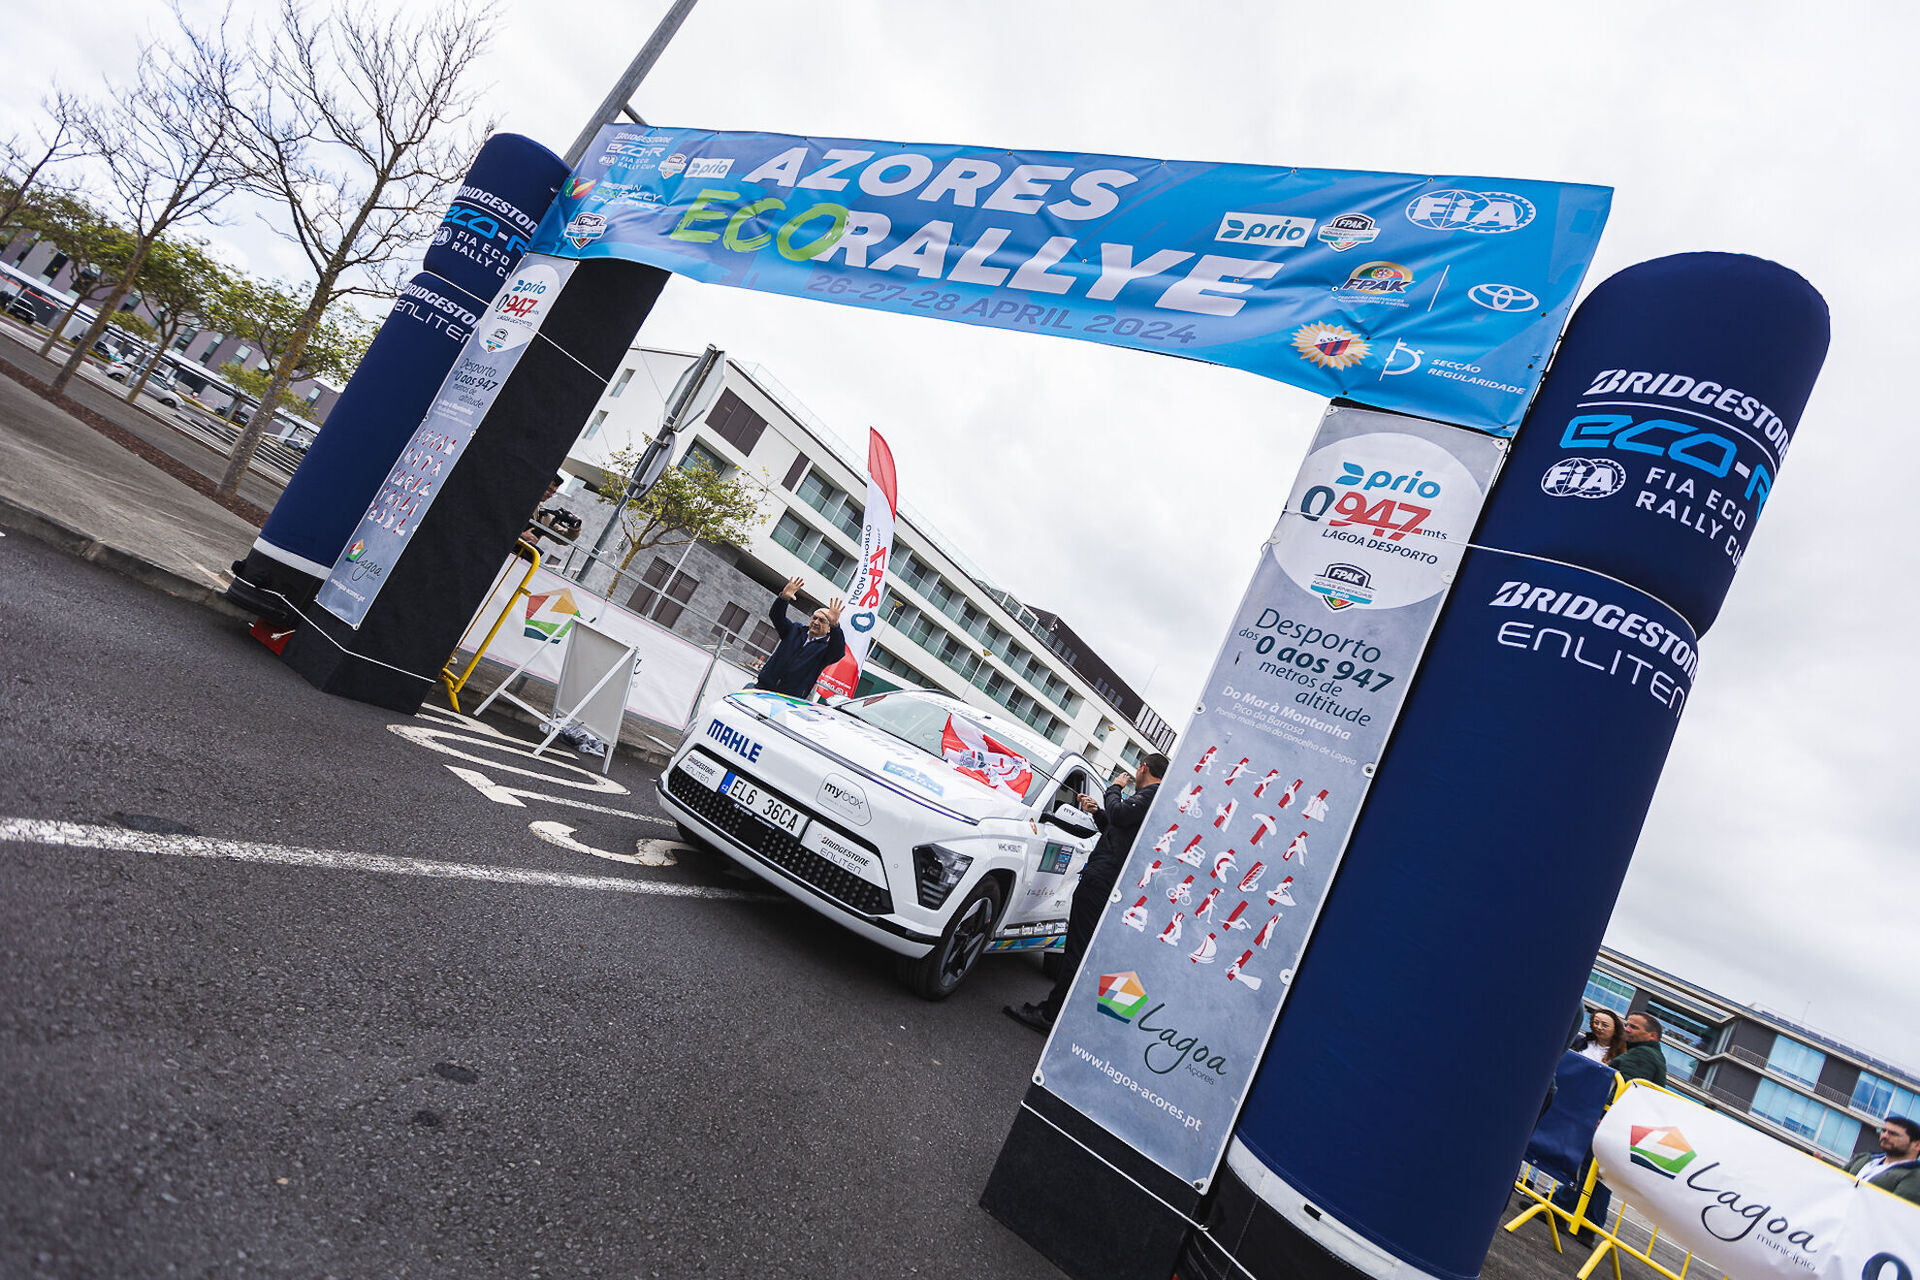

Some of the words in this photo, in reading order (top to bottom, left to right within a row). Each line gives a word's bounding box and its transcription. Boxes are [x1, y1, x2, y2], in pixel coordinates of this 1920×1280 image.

[618, 162, 640, 170] RALLY
[743, 147, 1139, 220] AZORES
[1244, 219, 1306, 241] prio
[1337, 219, 1366, 229] FPAK
[451, 241, 493, 268] RALLY
[495, 266, 510, 280] C
[456, 230, 477, 247] FIA
[481, 242, 511, 266] ECO
[520, 280, 547, 295] prio
[1341, 278, 1416, 293] FPAK
[805, 273, 961, 312] 26-27-28
[963, 296, 1072, 331] APRIL
[1084, 313, 1197, 344] 2024
[459, 374, 477, 386] aos
[475, 377, 499, 392] 947
[460, 357, 497, 378] Desporto
[1427, 367, 1527, 395] REGULARIDADE
[1431, 358, 1481, 373] SECÇÃO
[1362, 470, 1442, 499] prio
[1645, 467, 1696, 500] FIA
[1704, 488, 1747, 532] ECO
[1635, 489, 1724, 541] RALLY
[1321, 527, 1365, 547] LAGOA
[1366, 537, 1439, 566] DESPORTO
[1422, 528, 1448, 541] mts
[1331, 568, 1364, 584] FPAK
[1254, 607, 1382, 664] Desporto
[1238, 627, 1261, 641] dos
[1255, 635, 1276, 655] 0
[1276, 646, 1330, 674] aos
[1331, 660, 1396, 693] 947
[1258, 660, 1318, 690] metros
[1319, 680, 1343, 697] de
[1222, 685, 1242, 700] Do
[1242, 692, 1270, 710] Mar
[1268, 702, 1280, 714] à
[1280, 706, 1352, 741] Montanha
[1253, 711, 1266, 721] da
[1266, 714, 1306, 736] Barrosa
[1294, 690, 1372, 728] altitude
[706, 718, 764, 764] MAHLE
[1236, 715, 1256, 727] mais
[1255, 722, 1273, 733] alto
[1271, 727, 1283, 737] do
[1319, 745, 1331, 755] de
[730, 779, 758, 806] EL6
[762, 798, 799, 832] 36CA
[823, 781, 864, 811] mybox
[819, 847, 863, 875] ENLITEN
[820, 836, 871, 867] BRIDGESTONE
[1137, 1002, 1228, 1076] Lagoa
[1071, 1042, 1204, 1133] www.lagoa-acores.pt
[1184, 1063, 1216, 1087] Açores
[1686, 1161, 1818, 1254] Lagoa
